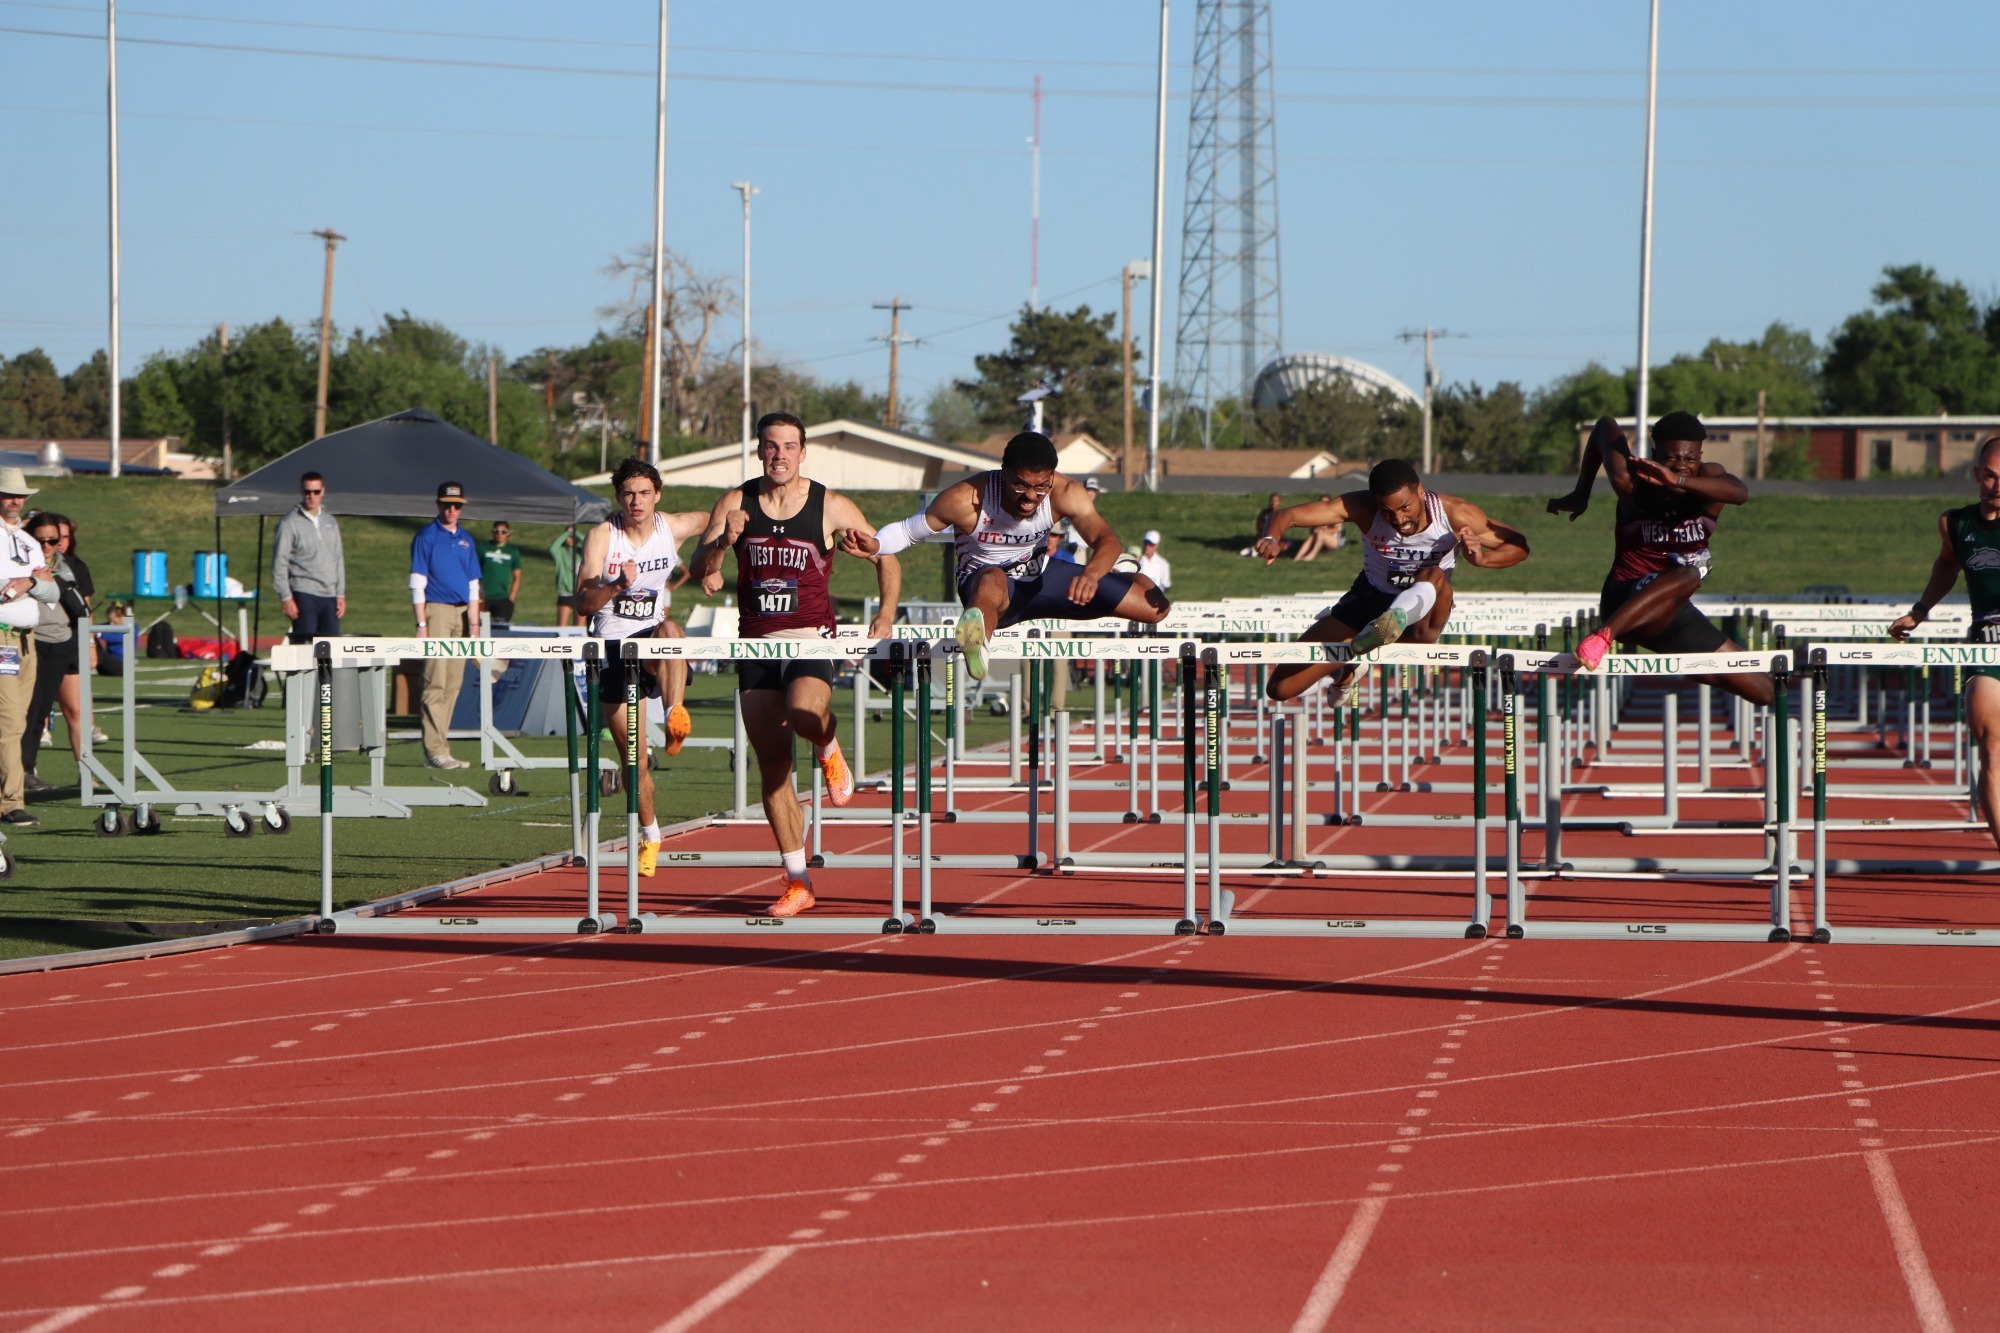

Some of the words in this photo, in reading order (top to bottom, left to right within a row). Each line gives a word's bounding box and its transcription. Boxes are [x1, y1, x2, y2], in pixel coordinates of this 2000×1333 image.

[1642, 524, 1669, 543] WEST
[1673, 523, 1705, 543] TEXAS
[635, 557, 669, 574] YLER
[749, 546, 774, 567] WEST
[777, 547, 809, 571] TEXAS
[618, 600, 653, 618] 1398
[758, 594, 791, 612] 1477
[1220, 619, 1271, 632] ENMU
[1851, 624, 1890, 636] ENM
[343, 645, 376, 653] UCS
[422, 640, 496, 657] ENMU
[540, 645, 573, 653] UCS
[650, 646, 683, 655] UCS
[728, 642, 801, 659] ENMU
[845, 646, 878, 655] UCS
[942, 645, 964, 653] UC
[1021, 641, 1093, 657] ENMU
[1138, 645, 1170, 654] UCS
[1230, 650, 1262, 659] UCS
[1427, 652, 1459, 660] UCS
[1839, 651, 1873, 659] UCS
[1922, 647, 1998, 664] ENMU
[1526, 659, 1559, 668] UCS
[1606, 657, 1683, 674] ENMU
[1727, 659, 1760, 668] UCS
[321, 683, 331, 704] USA
[627, 684, 637, 704] USA
[1207, 689, 1217, 709] USA
[1815, 690, 1826, 710] USA
[1504, 694, 1513, 714] USA
[321, 705, 332, 767] TRACKTOWN
[627, 705, 637, 766] TRACKTOWN
[1207, 710, 1217, 770] TRACKTOWN
[1815, 712, 1826, 774] TRACKTOWN
[1504, 715, 1515, 775] TRACKTOWN
[745, 918, 784, 926] UCS
[1327, 920, 1366, 928] UCS
[1627, 925, 1666, 933] UCS
